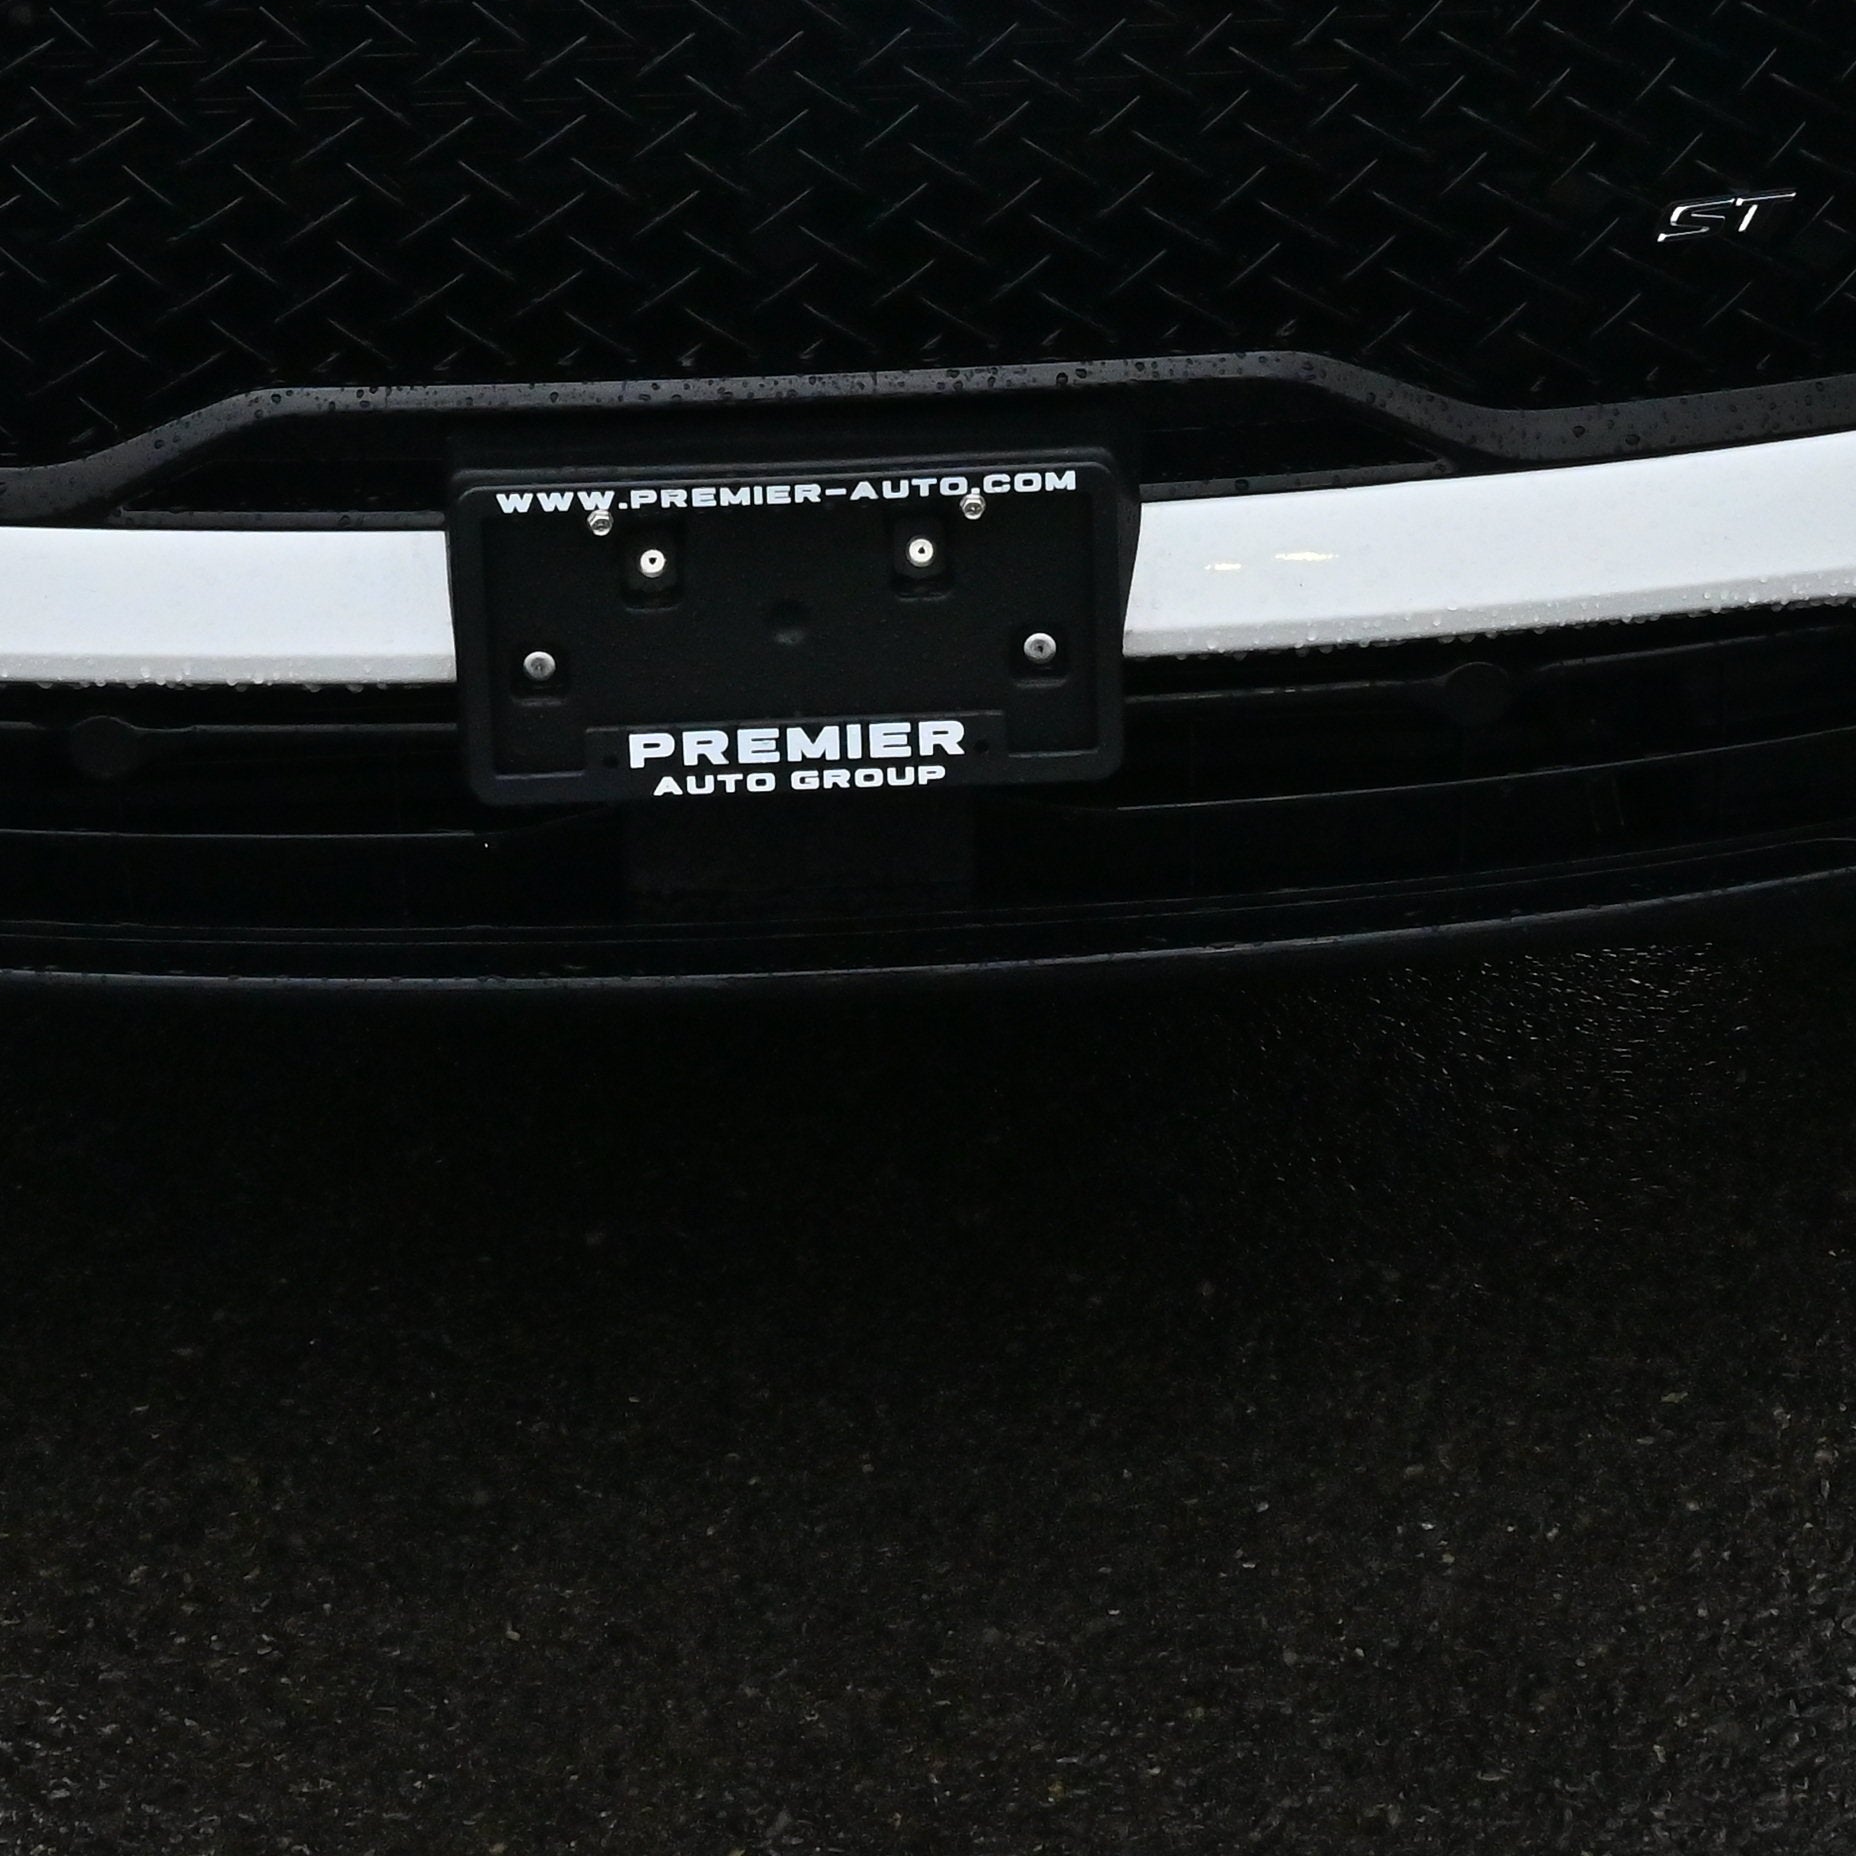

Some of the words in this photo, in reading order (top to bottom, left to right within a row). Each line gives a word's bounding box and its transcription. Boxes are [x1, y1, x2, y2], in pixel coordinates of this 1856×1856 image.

[1655, 188, 1798, 243] ST
[494, 470, 1077, 515] WWW.PREMIER-AUTO.COM
[627, 719, 966, 770] PREMIER
[652, 772, 776, 797] AUTO
[789, 765, 948, 792] GROUP
